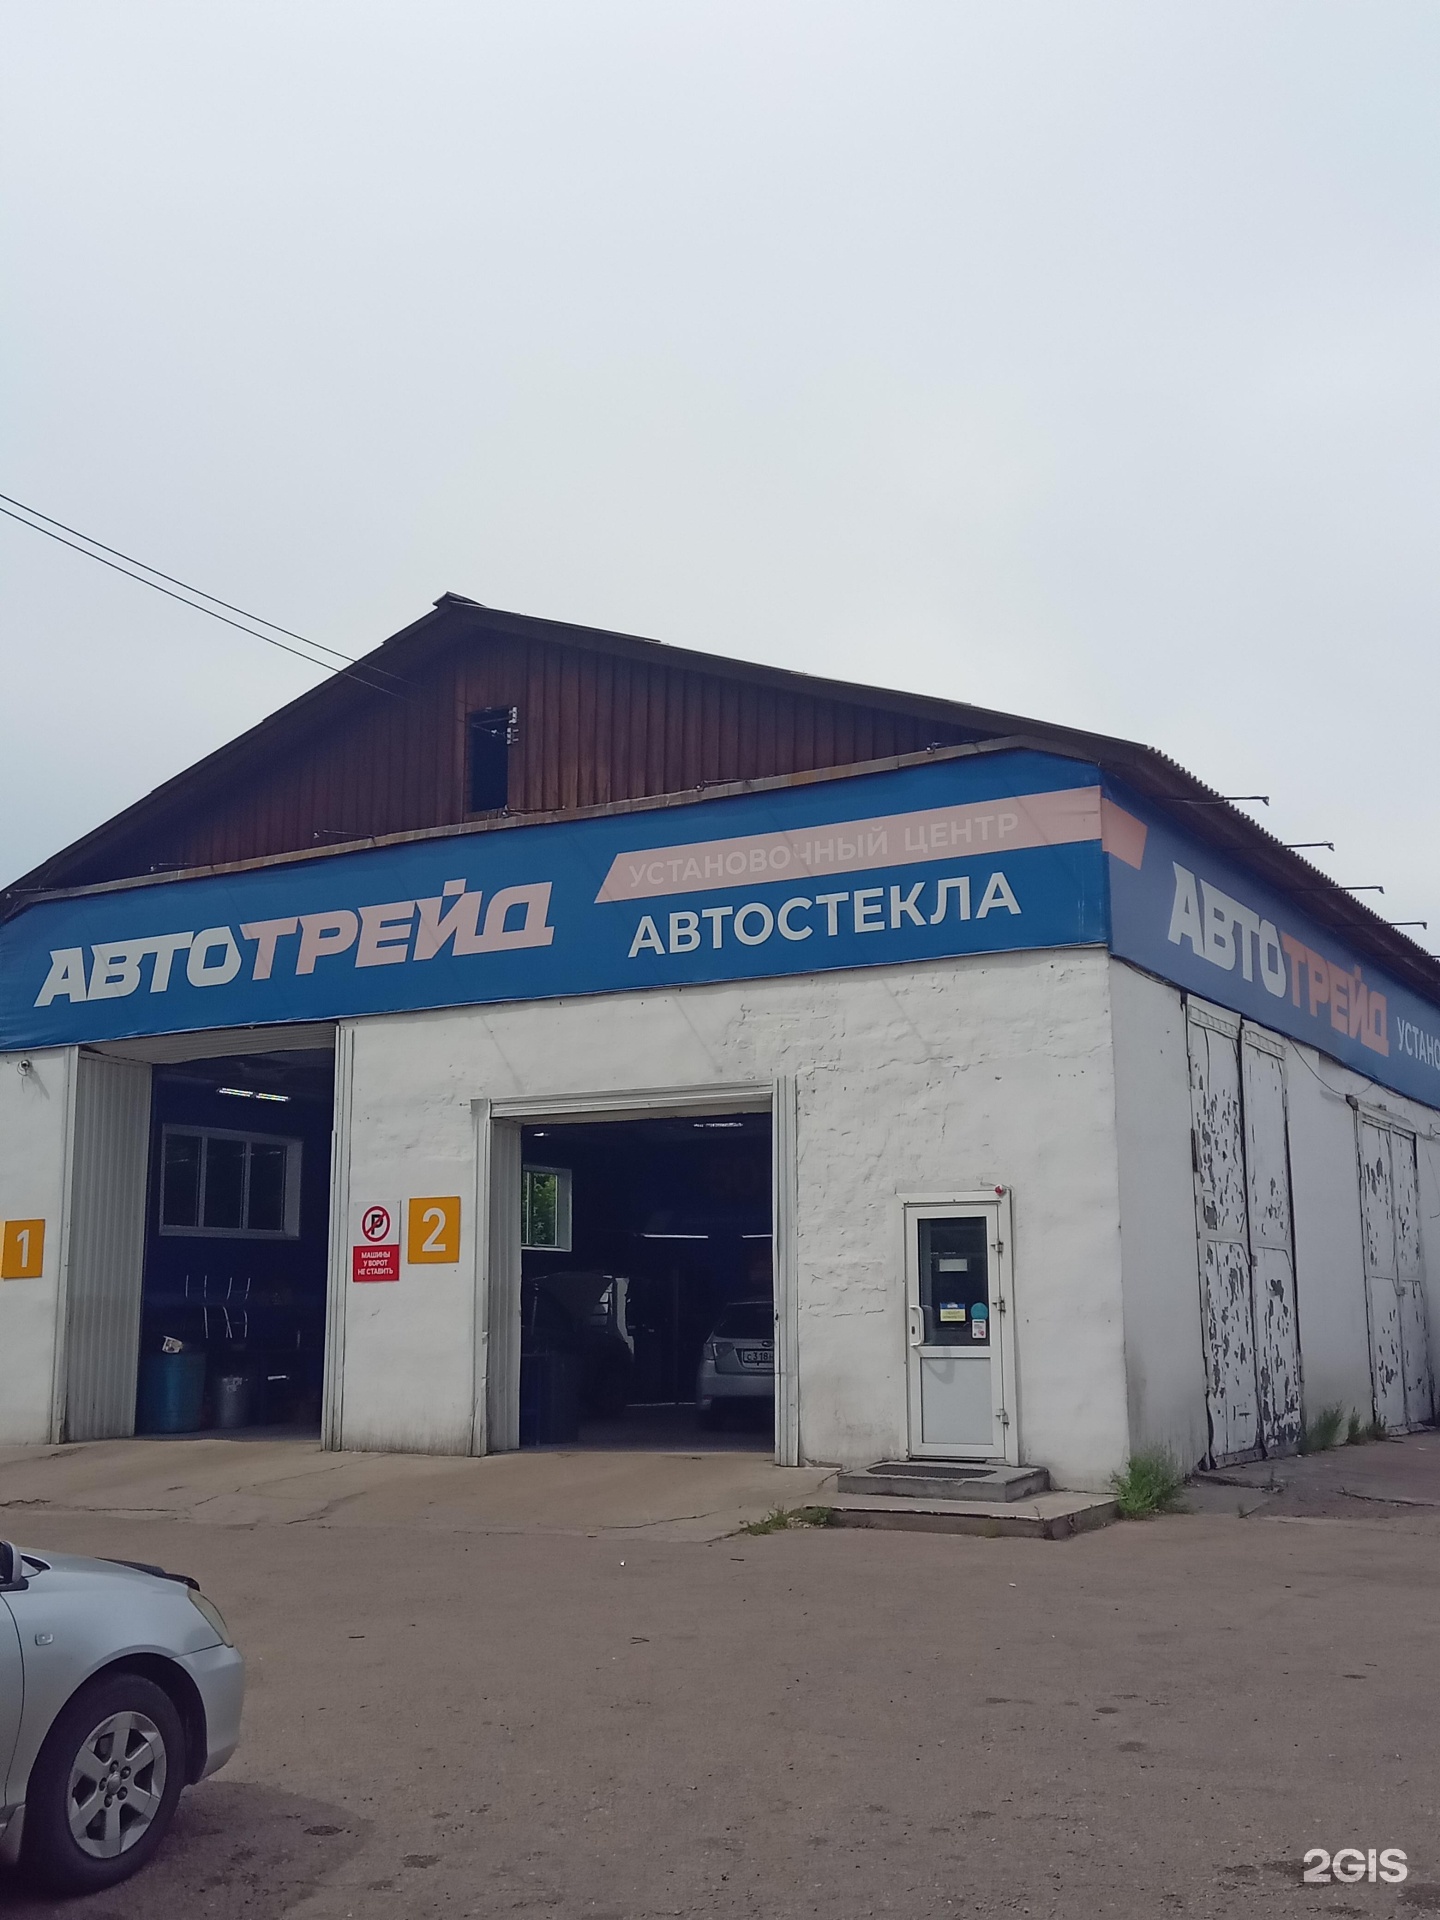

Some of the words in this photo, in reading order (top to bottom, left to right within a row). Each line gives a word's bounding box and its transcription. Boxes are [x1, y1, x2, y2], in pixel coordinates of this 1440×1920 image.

[629, 826, 888, 888] УСТАНОВОЧНЫЙ
[904, 813, 1019, 853] ЦЕНТР
[627, 871, 1022, 958] АВТОСТЕКЛА
[33, 878, 555, 1007] АВТОТРЕЙД
[1167, 861, 1389, 1057] АВТОТРЕЙД
[16, 1229, 30, 1268] 1
[422, 1207, 446, 1252] 2
[357, 1268, 366, 1276] НЕ
[366, 1267, 394, 1275] СТАВИТЬ
[361, 1251, 390, 1259] МАШИНЫ
[368, 1259, 388, 1267] ВОРОТ
